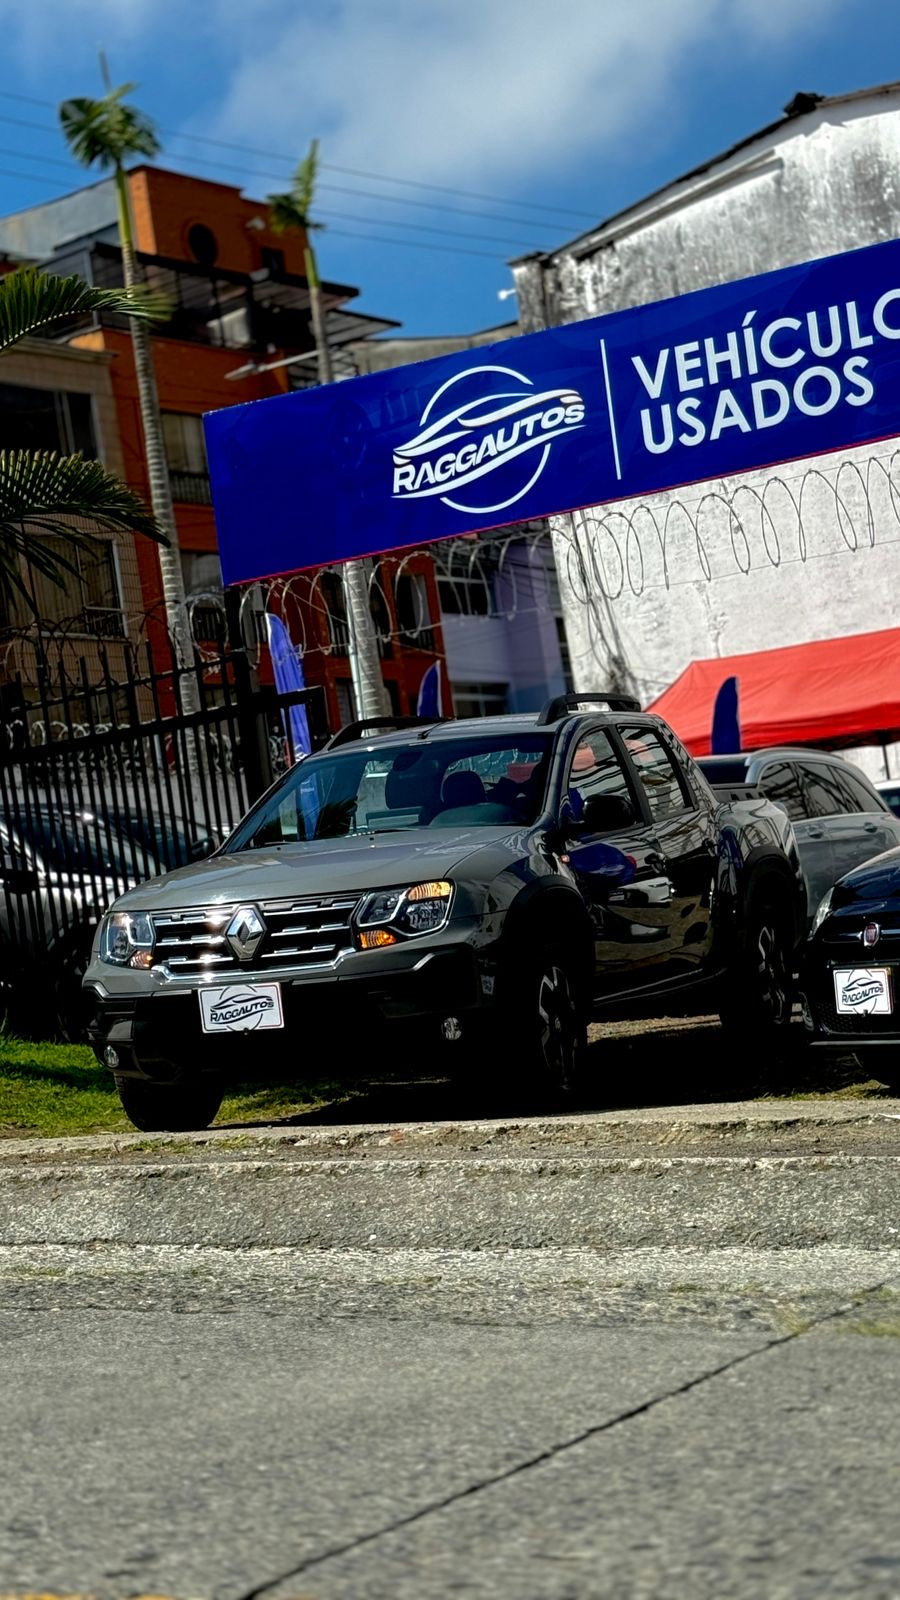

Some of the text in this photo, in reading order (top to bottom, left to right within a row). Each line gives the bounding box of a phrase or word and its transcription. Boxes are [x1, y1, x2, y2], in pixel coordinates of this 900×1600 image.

[393, 404, 585, 493] RAGGAUTOS
[640, 356, 874, 454] USADOS
[210, 1001, 274, 1022] RAGGAUTOS
